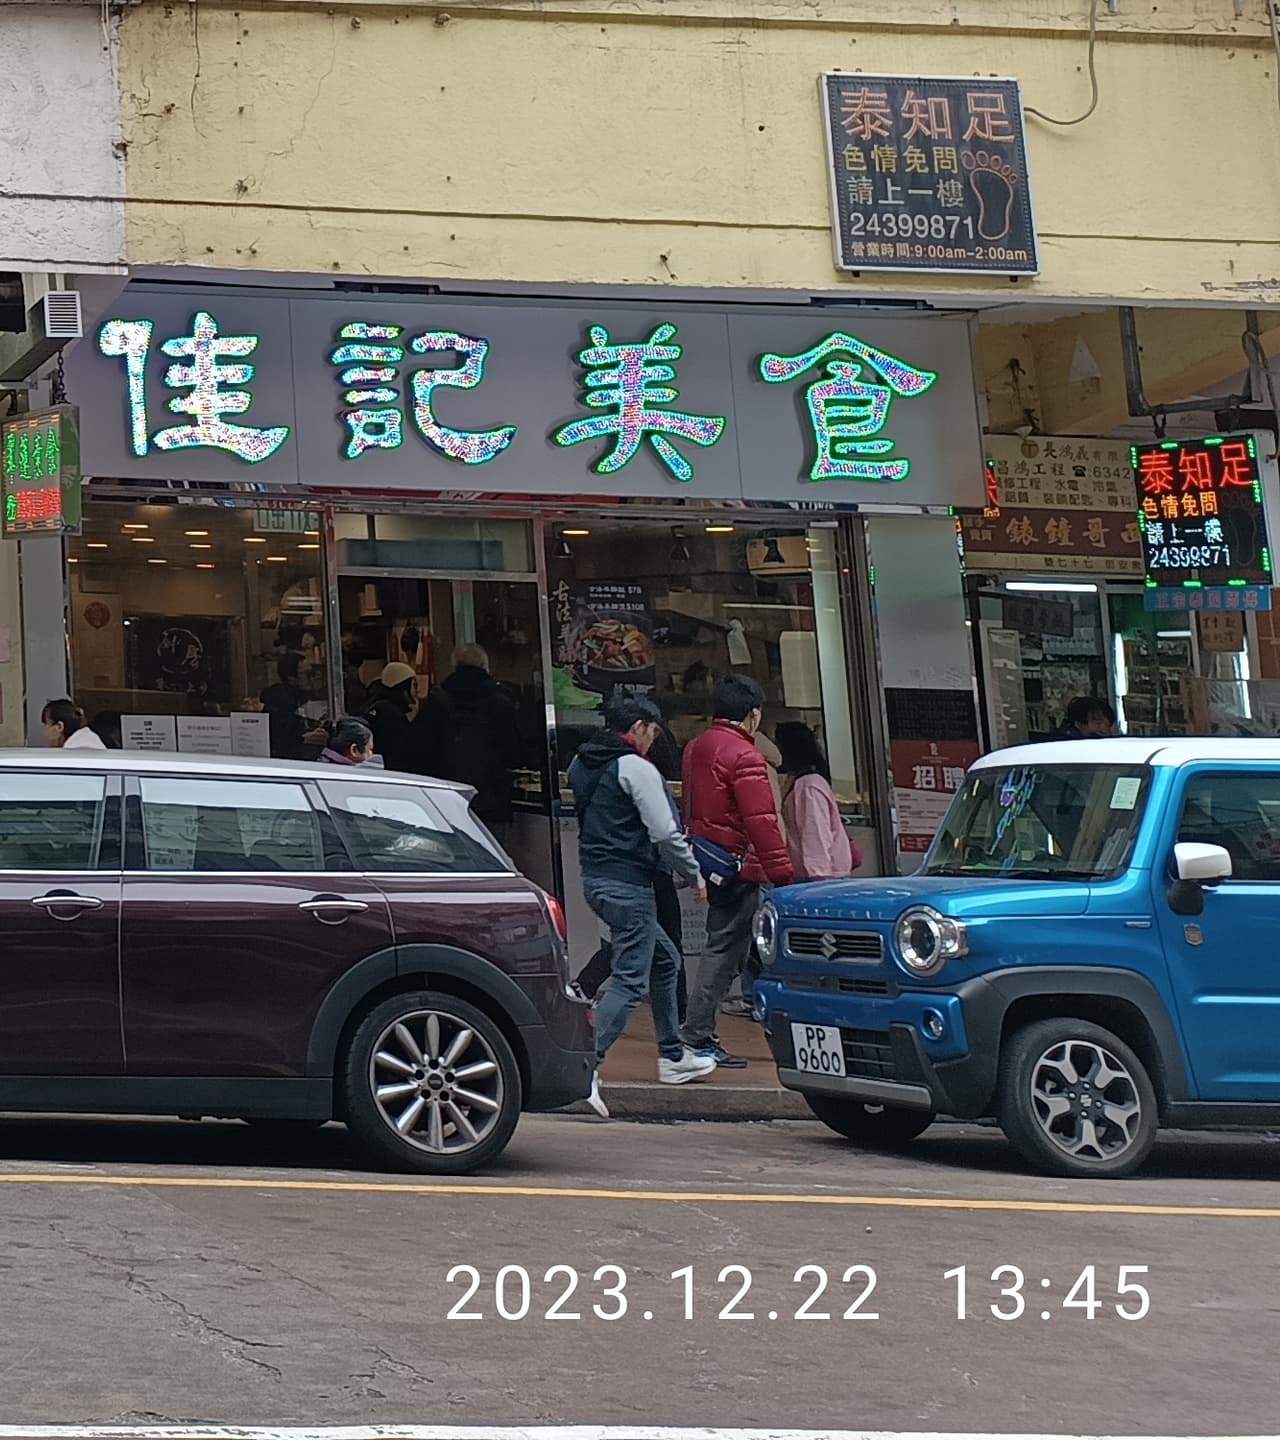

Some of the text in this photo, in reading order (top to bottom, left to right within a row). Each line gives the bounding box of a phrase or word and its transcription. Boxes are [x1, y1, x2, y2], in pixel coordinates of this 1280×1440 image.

[841, 87, 1016, 143] 泰知足
[841, 144, 959, 174] 色情免問
[846, 176, 964, 208] 請上一樓
[850, 212, 975, 240] 24399871
[99, 311, 937, 482] 佳記美食
[1139, 442, 1254, 494] 泰知足
[1142, 491, 1219, 519] 色情免問
[804, 1025, 827, 1047] PP
[799, 1047, 841, 1075] 9600
